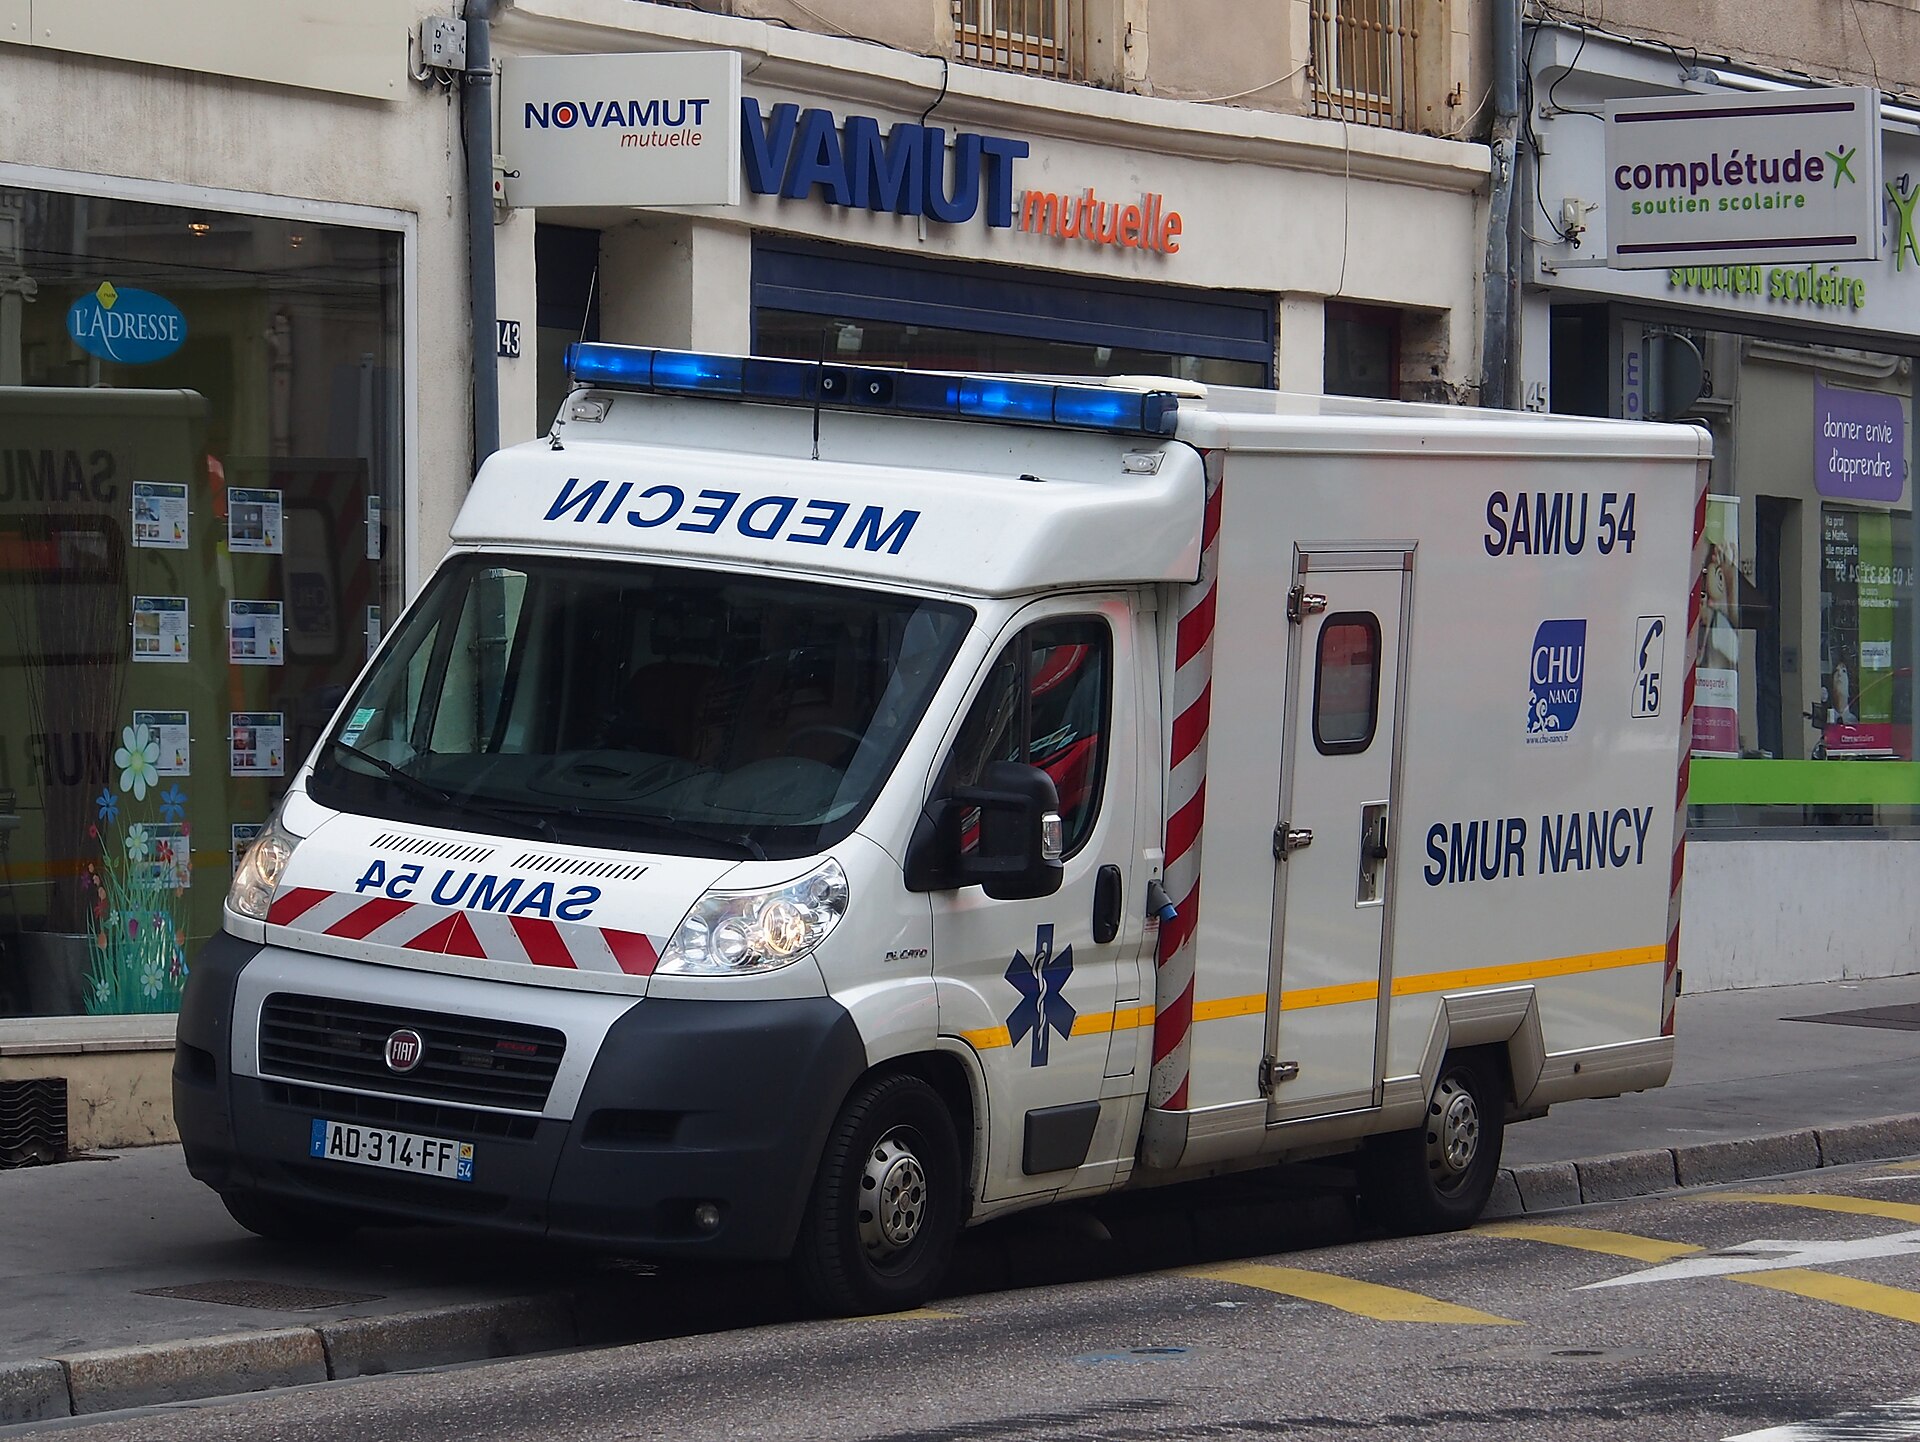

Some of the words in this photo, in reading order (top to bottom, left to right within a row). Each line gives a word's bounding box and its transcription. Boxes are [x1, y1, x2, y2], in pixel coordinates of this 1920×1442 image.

[524, 99, 709, 128] NOVAMUT
[620, 129, 702, 147] mutuelle
[741, 97, 1029, 229] VAMUT
[1615, 149, 1825, 195] complétude
[1021, 187, 1183, 254] mutuelle
[1631, 196, 1710, 215] soutien
[1718, 192, 1806, 212] scolaire
[1770, 262, 1867, 309] scolaire
[75, 305, 179, 361] L'ADRESSE
[496, 322, 520, 354] 143
[1823, 412, 1862, 440] donner
[1865, 420, 1893, 444] envie
[1829, 447, 1892, 482] d'apprendre
[1484, 491, 1588, 557] SAMU
[1597, 492, 1636, 555] 54
[1532, 645, 1583, 685] CHU
[1549, 688, 1579, 704] NANCY
[1639, 672, 1660, 712] 15
[1424, 817, 1527, 887] SMUR
[1539, 806, 1654, 875] NANCY
[391, 1041, 415, 1062] FIAT
[315, 1141, 321, 1150] F
[330, 1125, 454, 1172] AD-314-FF
[457, 1162, 471, 1178] 54
